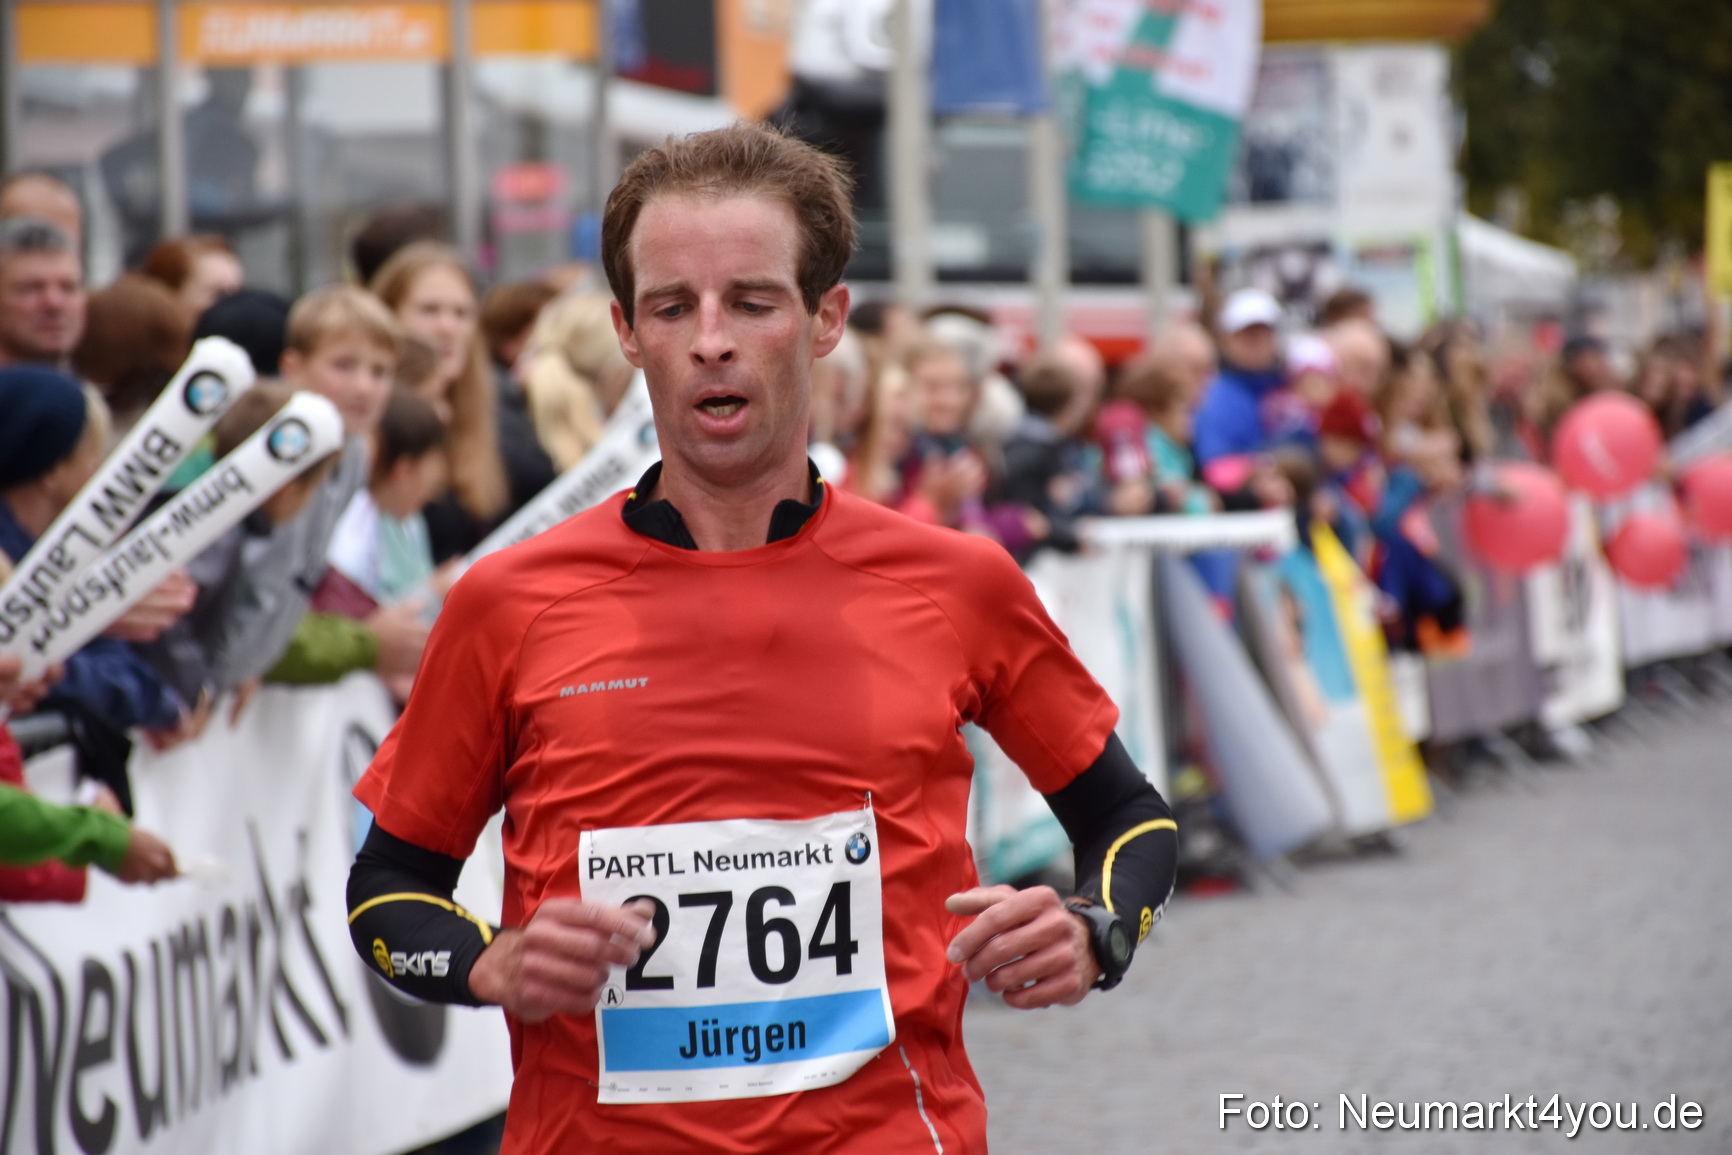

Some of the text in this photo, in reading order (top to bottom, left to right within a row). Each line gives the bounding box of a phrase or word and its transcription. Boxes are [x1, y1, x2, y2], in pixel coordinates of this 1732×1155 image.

[88, 427, 181, 531] BMW
[560, 677, 648, 698] MAMMUT
[588, 843, 833, 880] PARTL Neumarkt
[620, 880, 858, 991] 2764
[0, 817, 351, 1155] Neumarkt
[606, 987, 618, 1005] A
[679, 1018, 807, 1063] Jürgen
